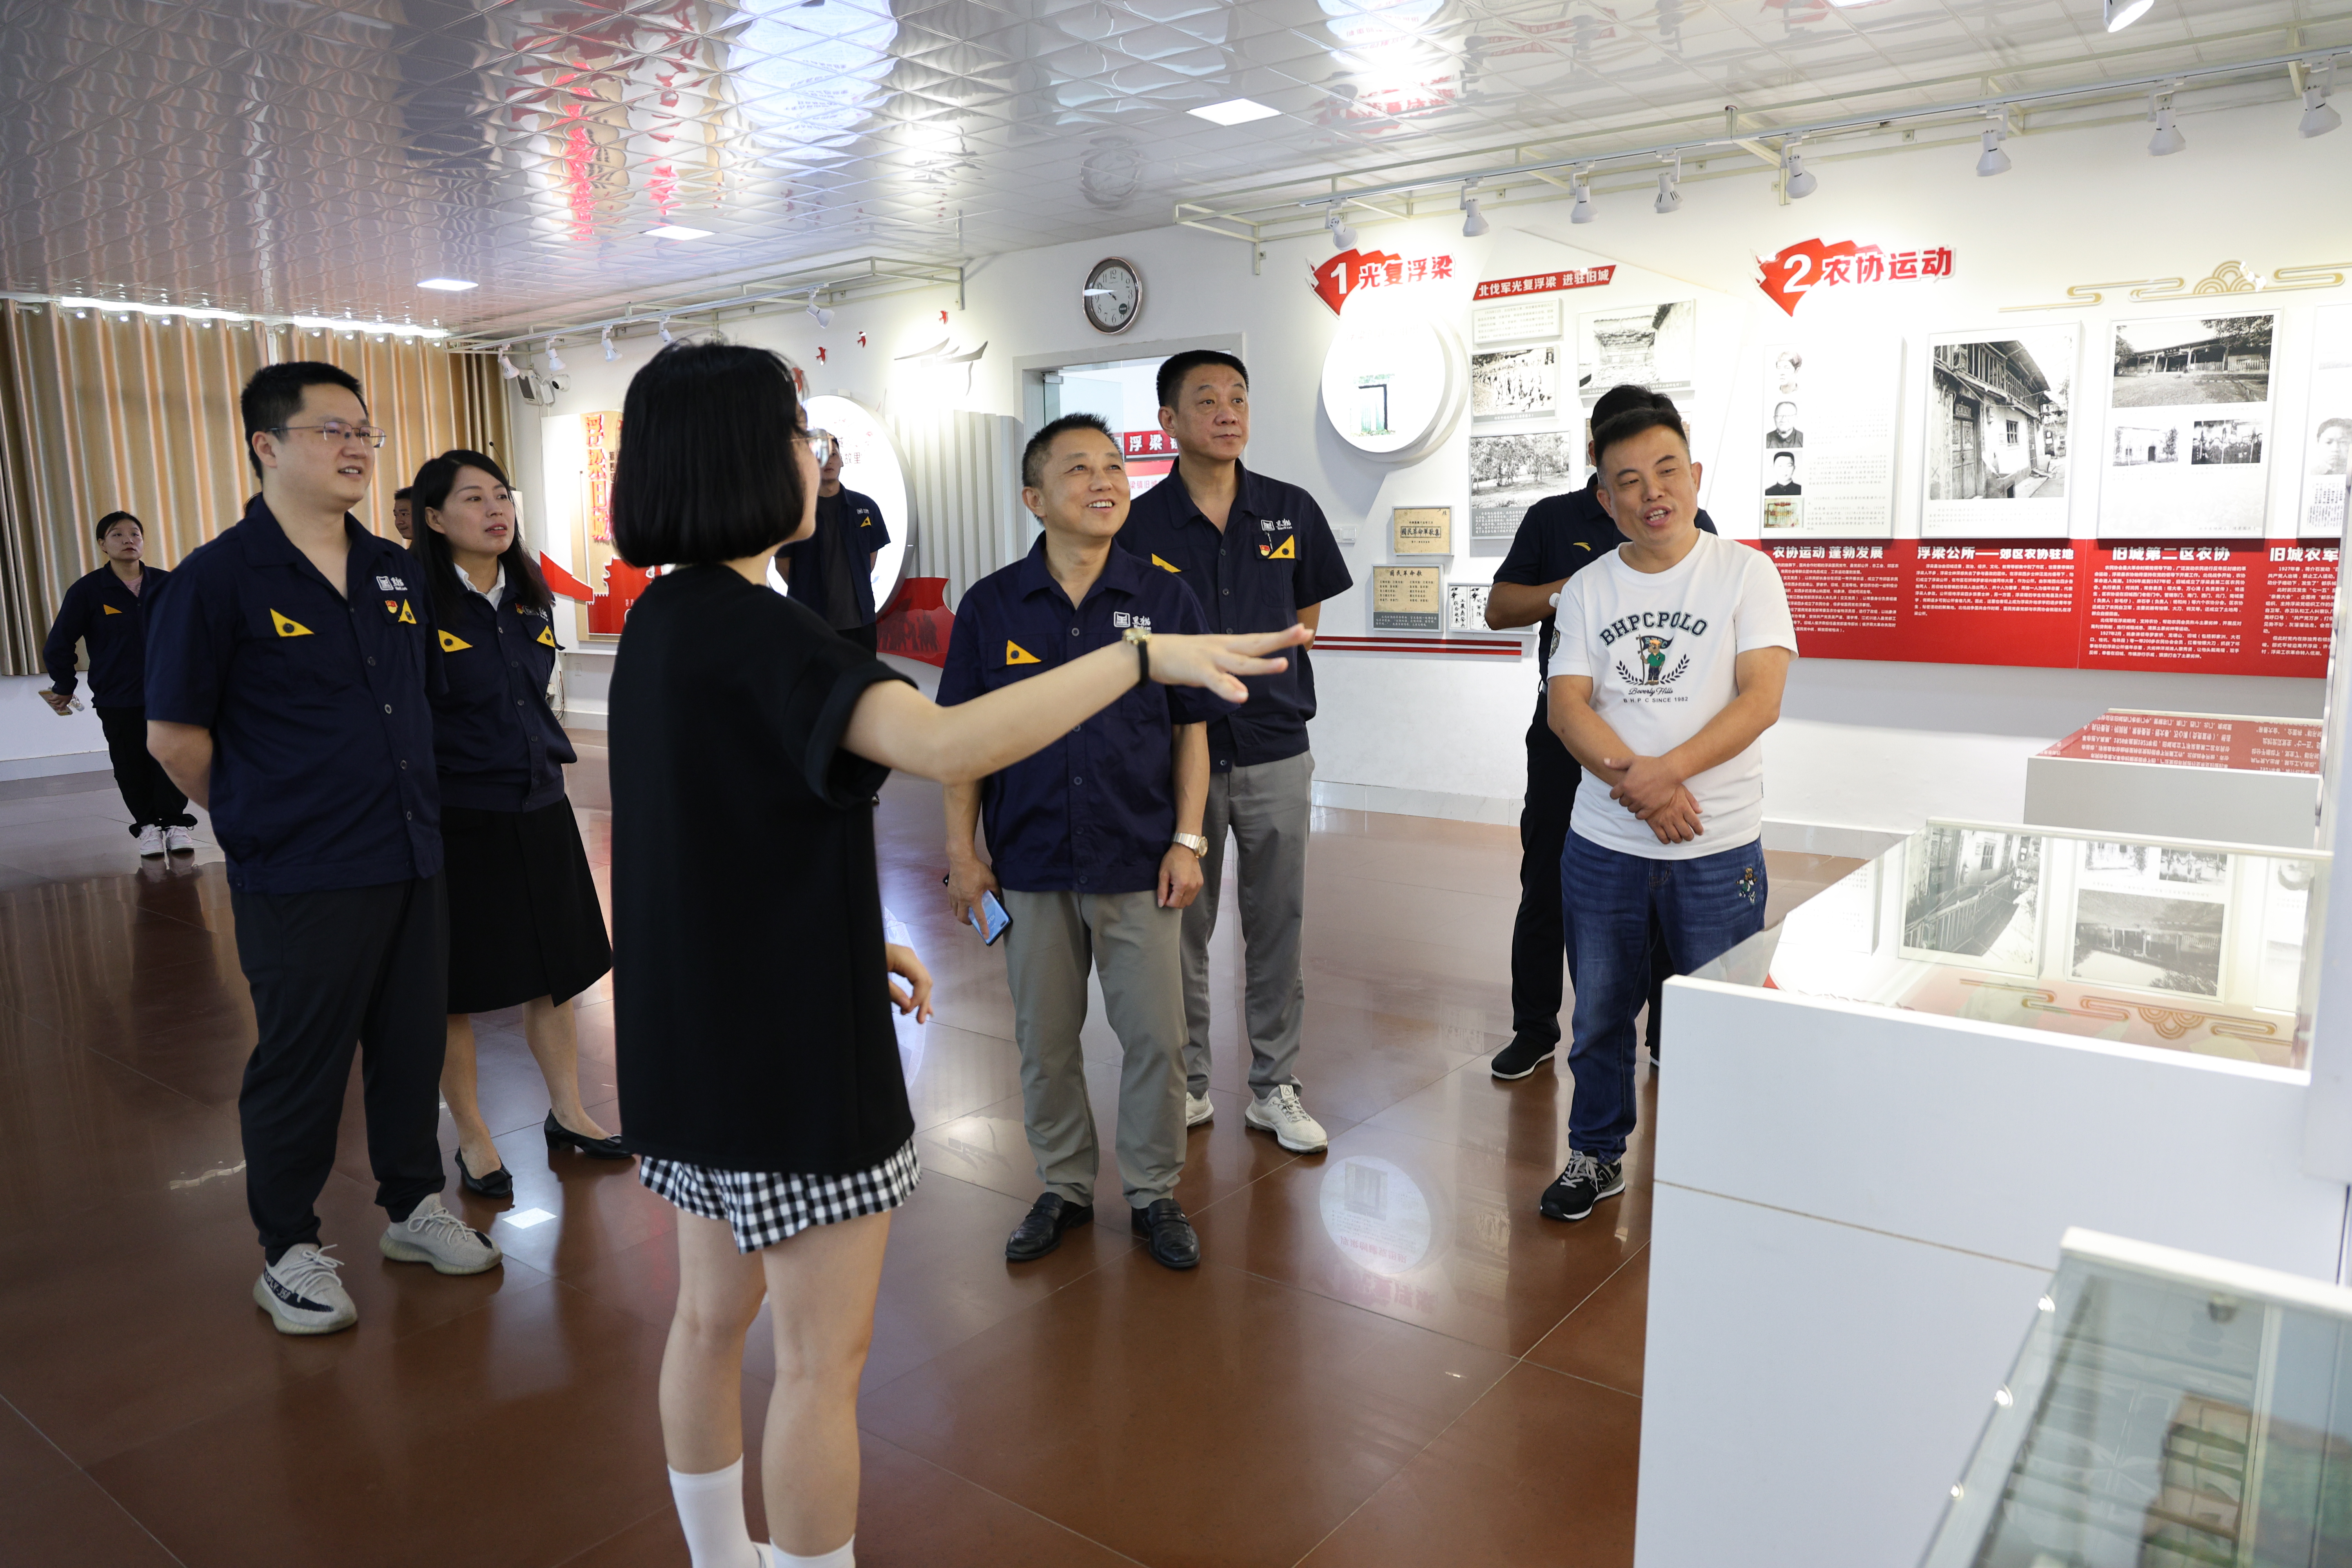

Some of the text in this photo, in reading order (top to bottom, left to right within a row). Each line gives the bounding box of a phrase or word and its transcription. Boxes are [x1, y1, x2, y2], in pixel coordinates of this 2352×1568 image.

[1330, 254, 1454, 295] 1 光复浮梁
[1783, 247, 1952, 292] 2 农协运动
[1479, 269, 1609, 297] 北伐军光复浮梁 进驻旧城
[1401, 527, 1440, 536] 國民革命軍歌集
[1773, 546, 1884, 559] 农协运动 蓬勃发展
[1917, 546, 2074, 560] 浮梁公所——郊区农协驻地
[2112, 546, 2230, 561] 旧城第二区农协
[2270, 547, 2339, 562] 旧城农军
[1628, 688, 1655, 697] Beverly
